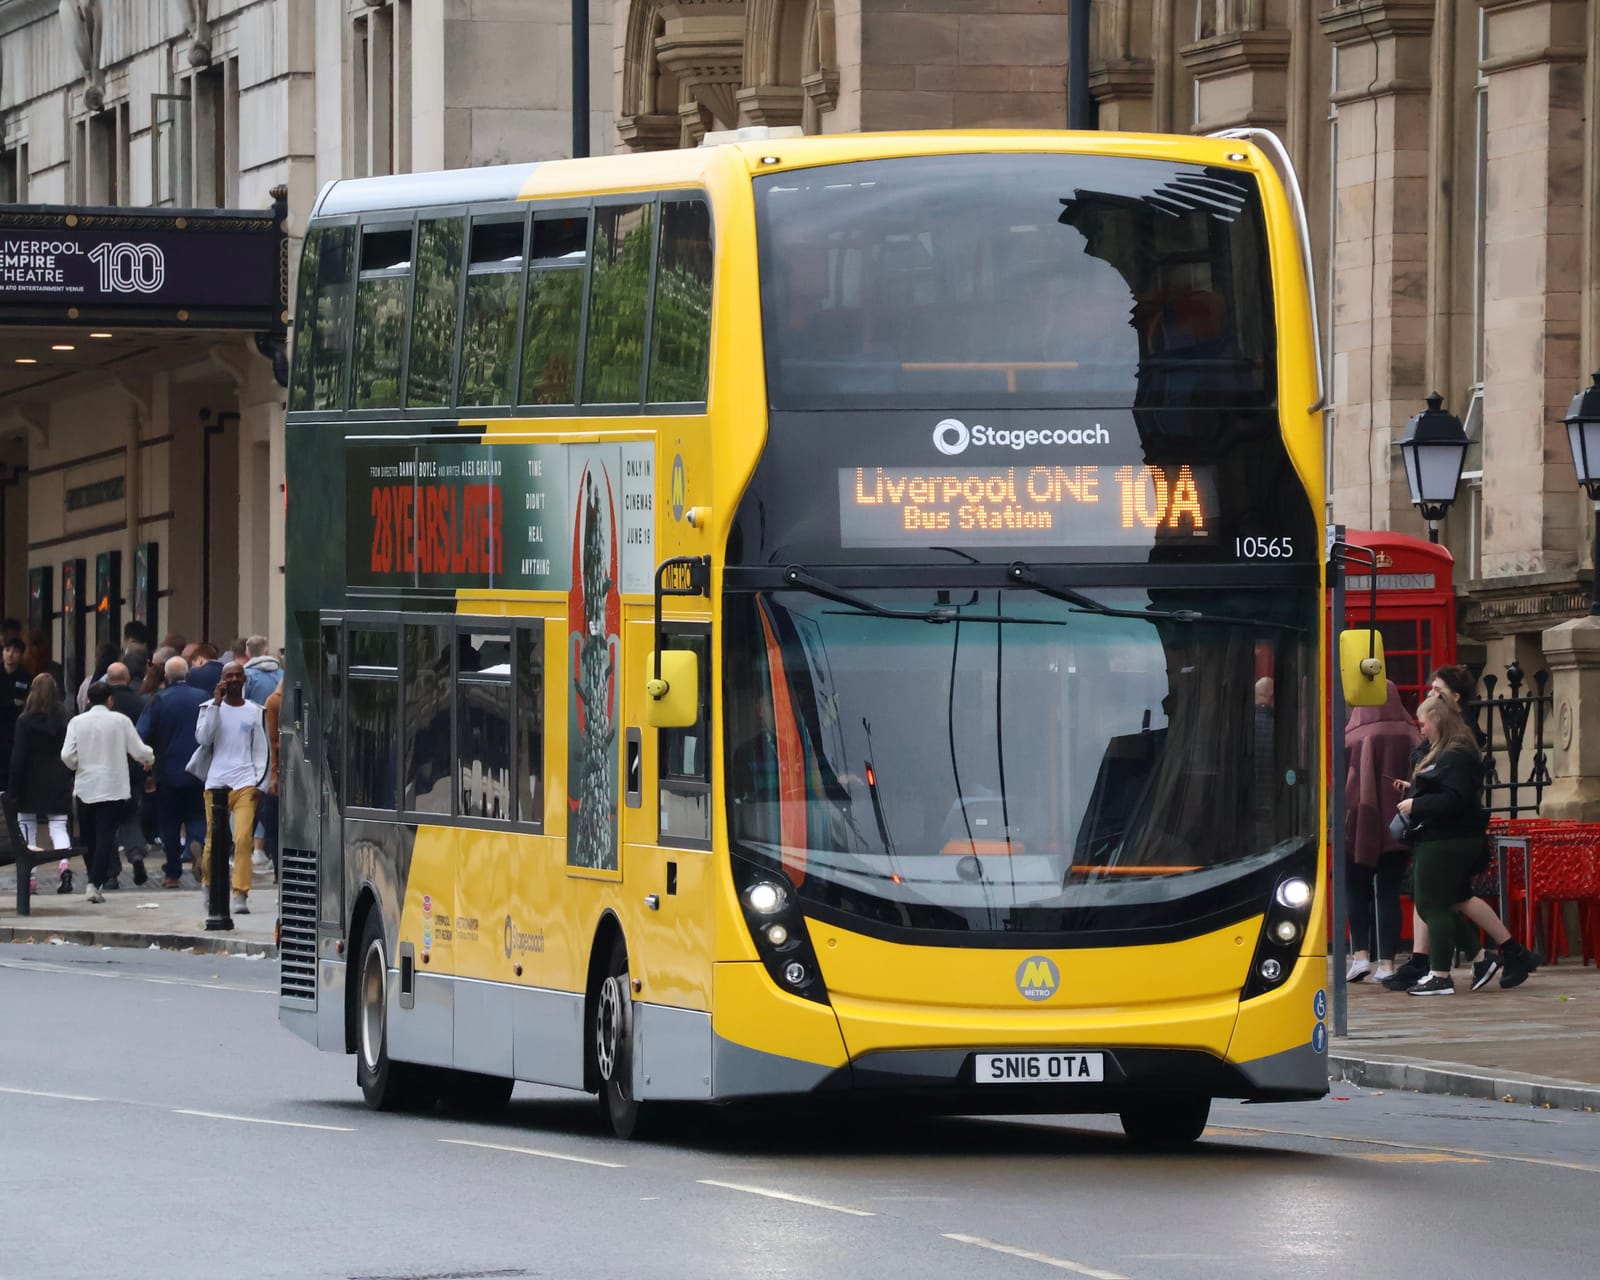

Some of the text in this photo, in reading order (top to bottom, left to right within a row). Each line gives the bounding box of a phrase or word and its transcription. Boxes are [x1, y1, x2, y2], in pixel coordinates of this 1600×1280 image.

[0, 241, 84, 254] IVERPOOL
[88, 243, 165, 293] 100
[971, 424, 1110, 450] Stagecoach
[399, 461, 418, 477] DANNY
[419, 461, 437, 478] BOYLE
[461, 460, 475, 477] ALEX
[475, 460, 502, 477] GARLAND
[528, 460, 542, 477] TIME
[626, 460, 651, 476] ONLY IN
[856, 465, 1099, 503] Liverpool ONE
[526, 493, 545, 510] DIDN'T
[625, 494, 652, 511] CINEMAS
[1113, 464, 1204, 529] 10A
[904, 504, 1052, 529] Bus Station
[371, 486, 393, 574] 28
[392, 485, 450, 574] YEARS
[626, 528, 651, 545] JUNE 19
[1236, 537, 1293, 558] 10565
[521, 559, 551, 575] ANYTHING
[665, 562, 693, 590] METRO
[1346, 574, 1432, 589] ELEPHONE
[1024, 989, 1050, 998] METRO
[990, 1055, 1091, 1079] SN16 OTA
